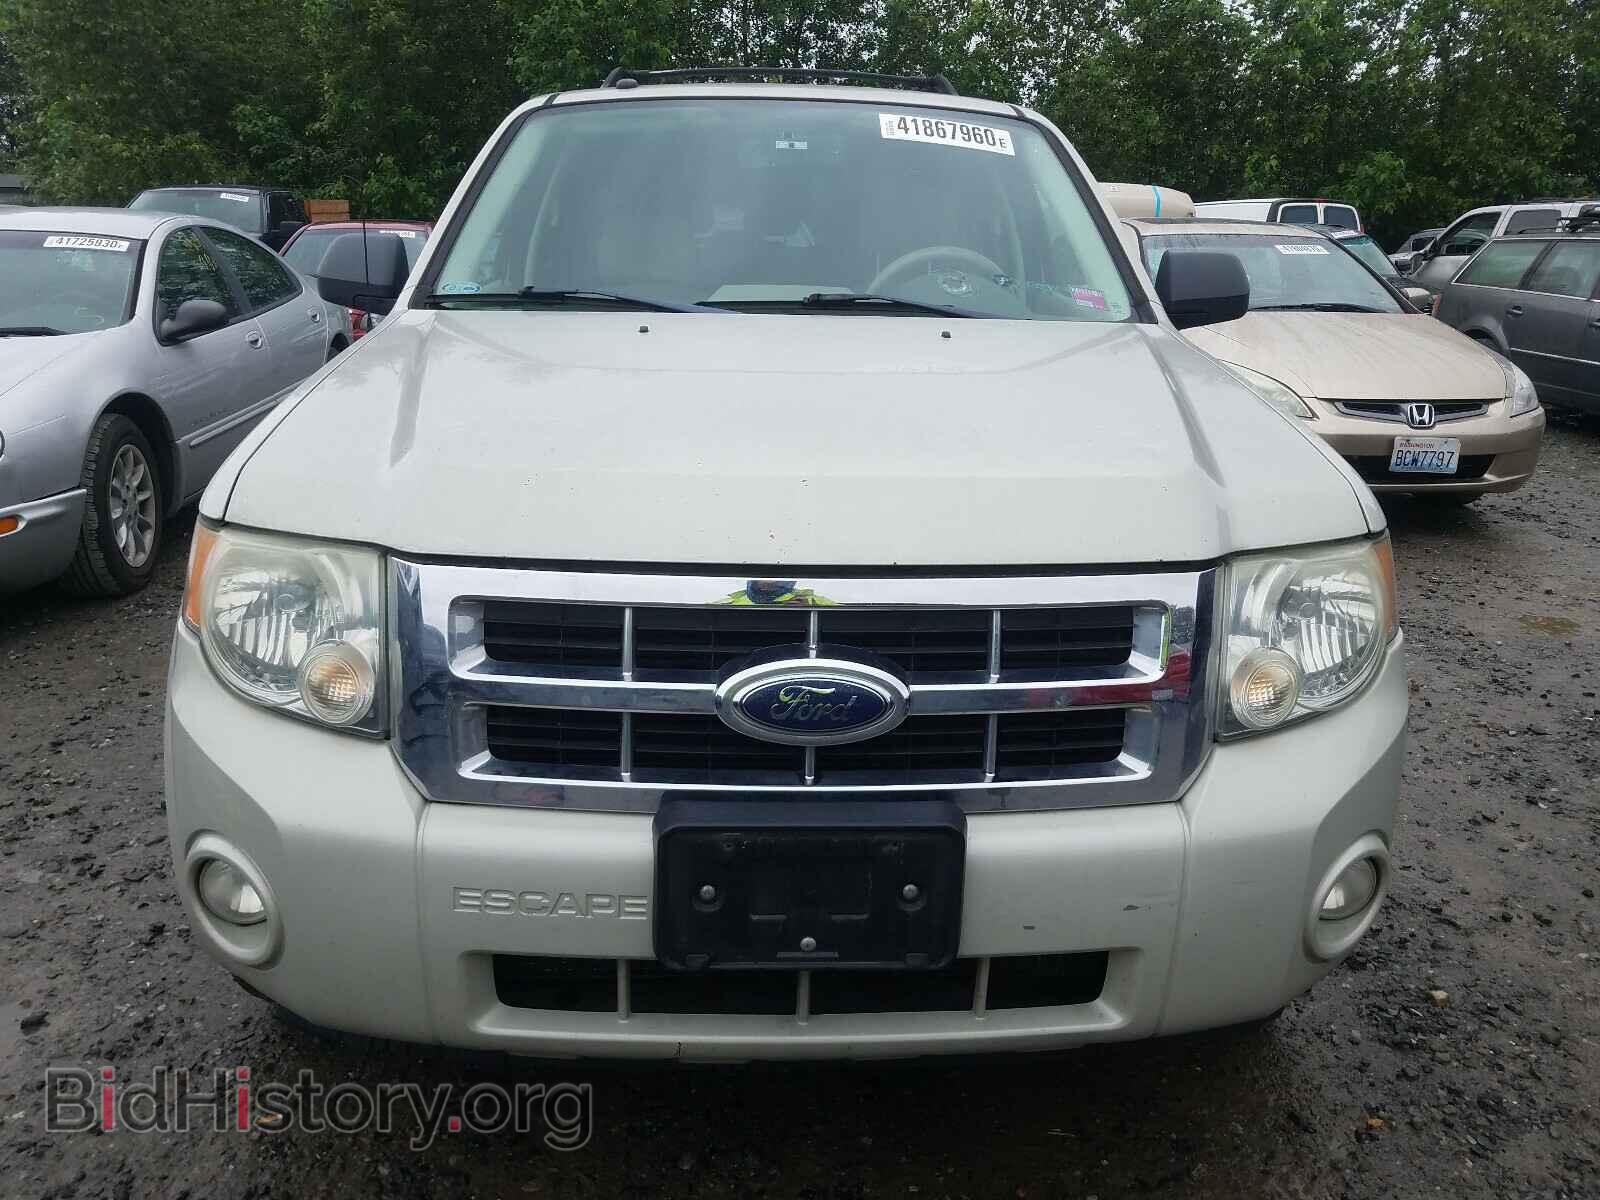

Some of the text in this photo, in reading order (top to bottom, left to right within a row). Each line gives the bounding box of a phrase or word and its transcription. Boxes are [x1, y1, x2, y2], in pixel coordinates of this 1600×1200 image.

[897, 116, 997, 147] 41867960
[1395, 449, 1455, 469] BCW7797
[768, 684, 859, 721] Ford
[452, 886, 649, 921] ESCAPE
